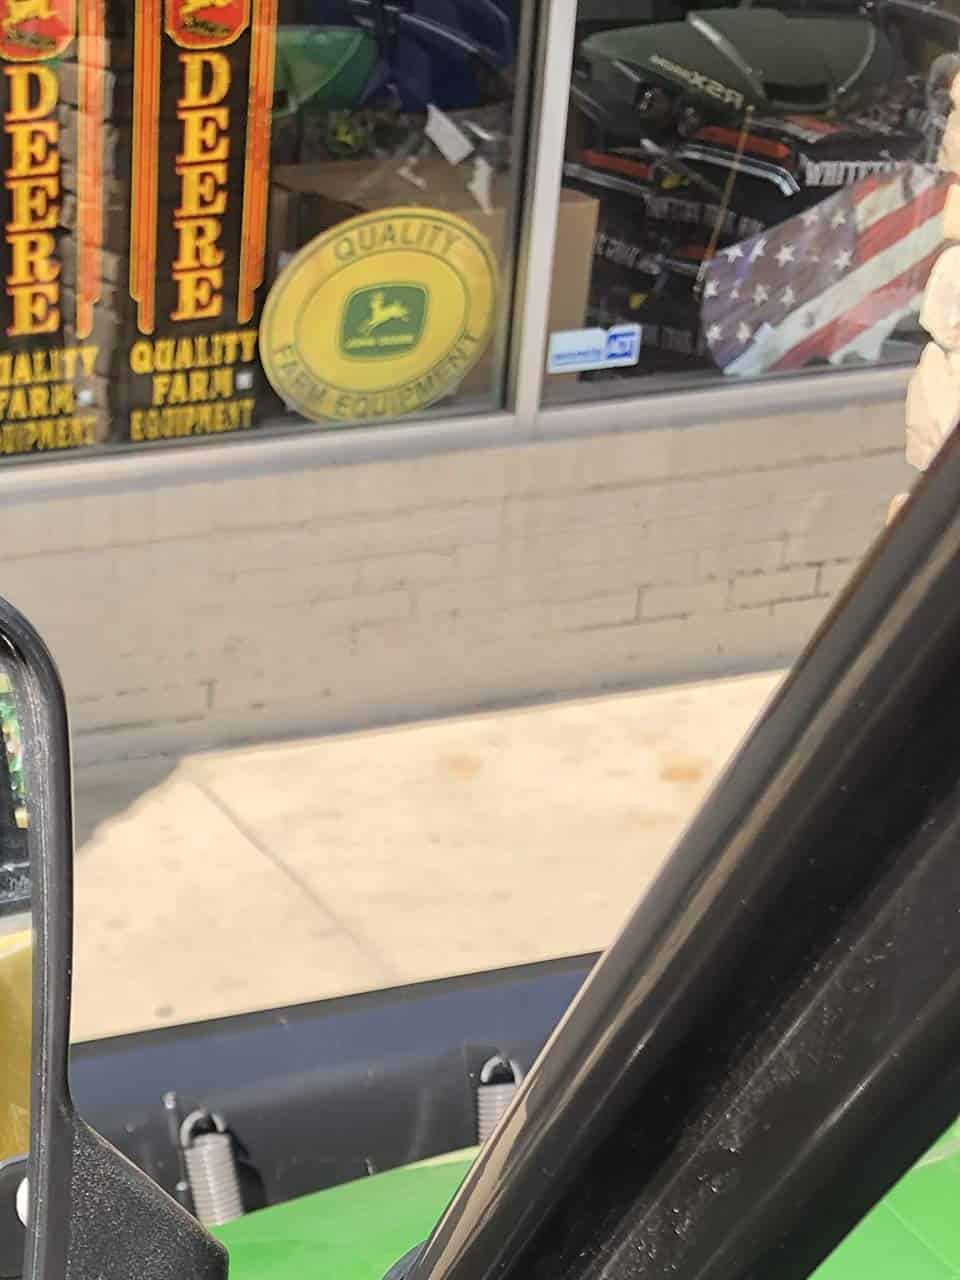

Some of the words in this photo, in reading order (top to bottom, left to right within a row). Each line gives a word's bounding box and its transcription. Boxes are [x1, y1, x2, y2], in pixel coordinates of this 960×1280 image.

[3, 63, 62, 338] DEERE
[171, 51, 232, 322] DEERE
[334, 220, 462, 262] QUALITY
[130, 331, 259, 376] QUALITY
[151, 367, 234, 407] FARM
[130, 399, 256, 442] EQUIPMENT
